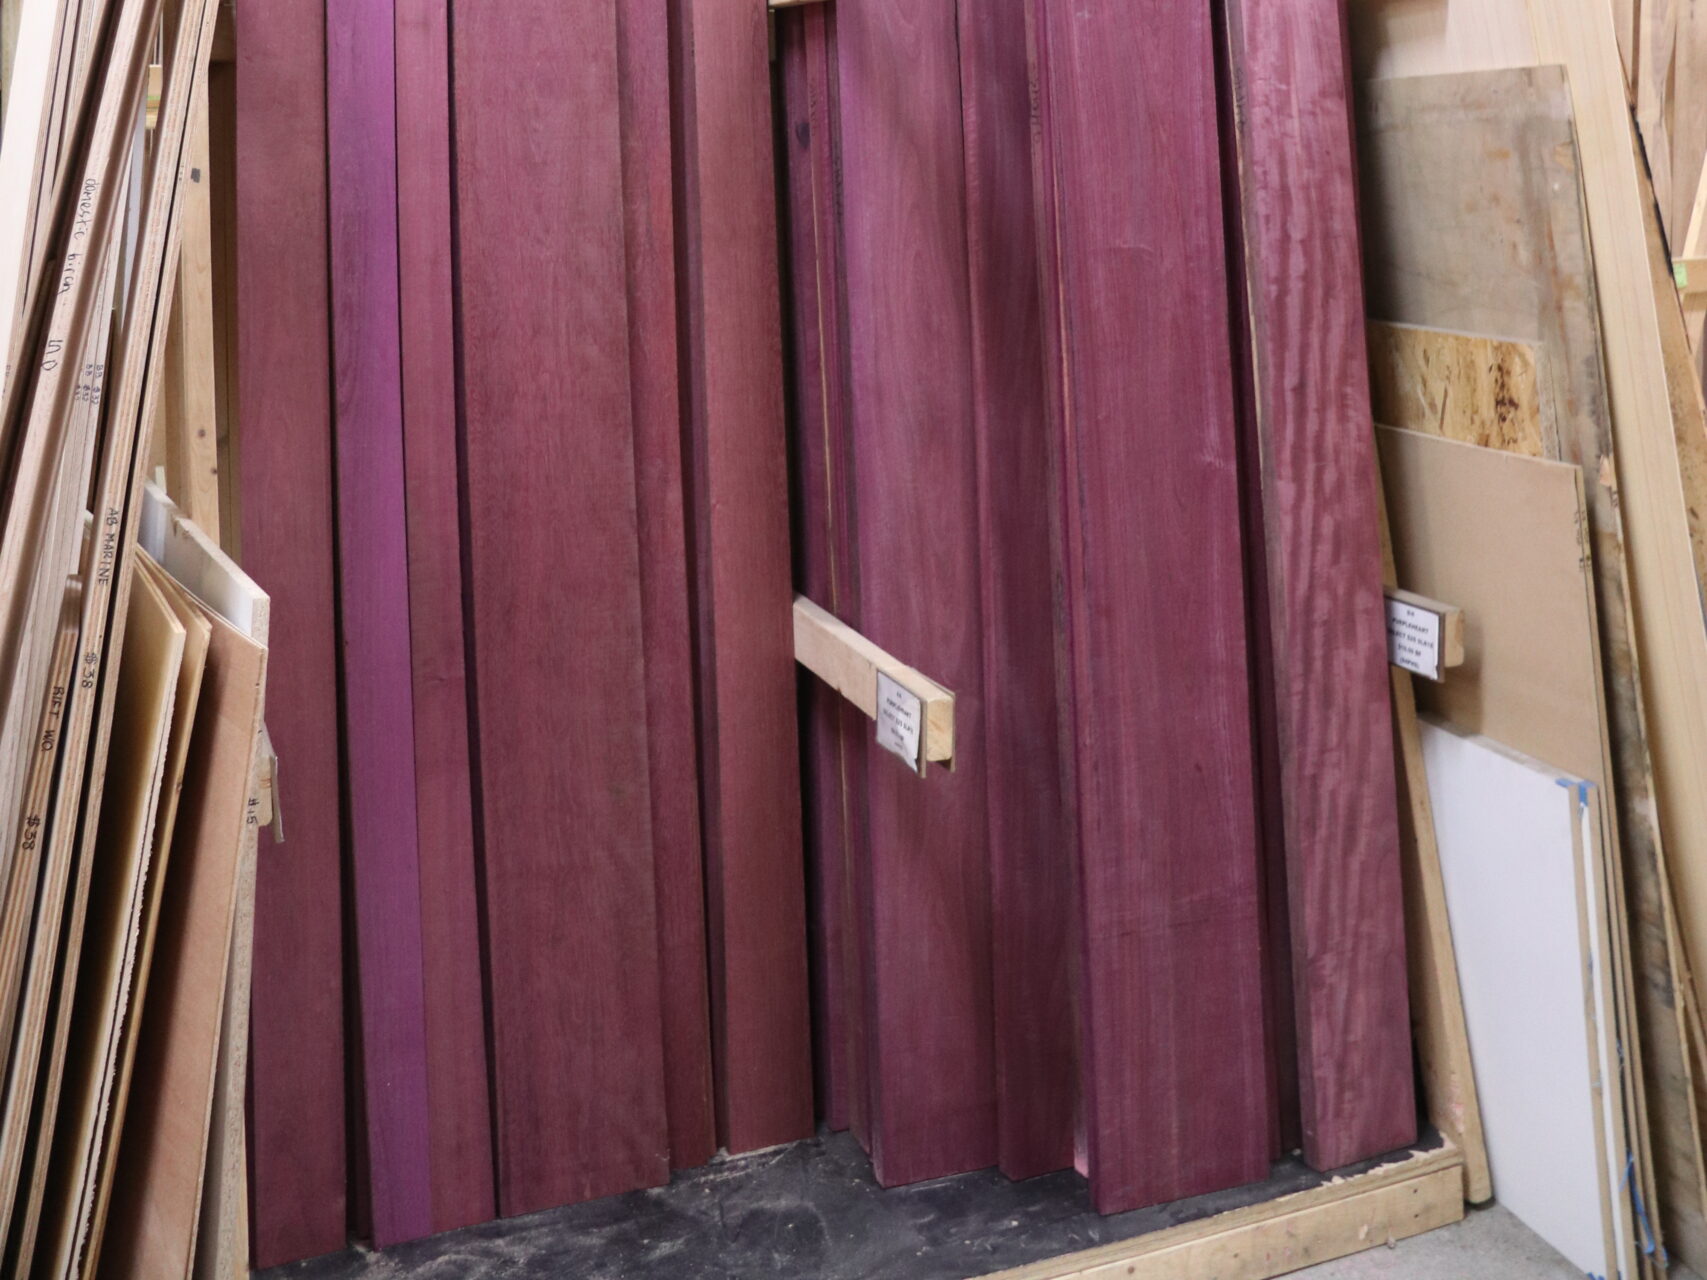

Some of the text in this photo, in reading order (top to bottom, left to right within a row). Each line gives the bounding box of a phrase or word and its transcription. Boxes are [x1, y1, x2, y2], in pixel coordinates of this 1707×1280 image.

[74, 178, 100, 240] domestic
[98, 507, 119, 585] AB MARINE
[48, 686, 65, 720] RIFT
[22, 815, 40, 851] $38
